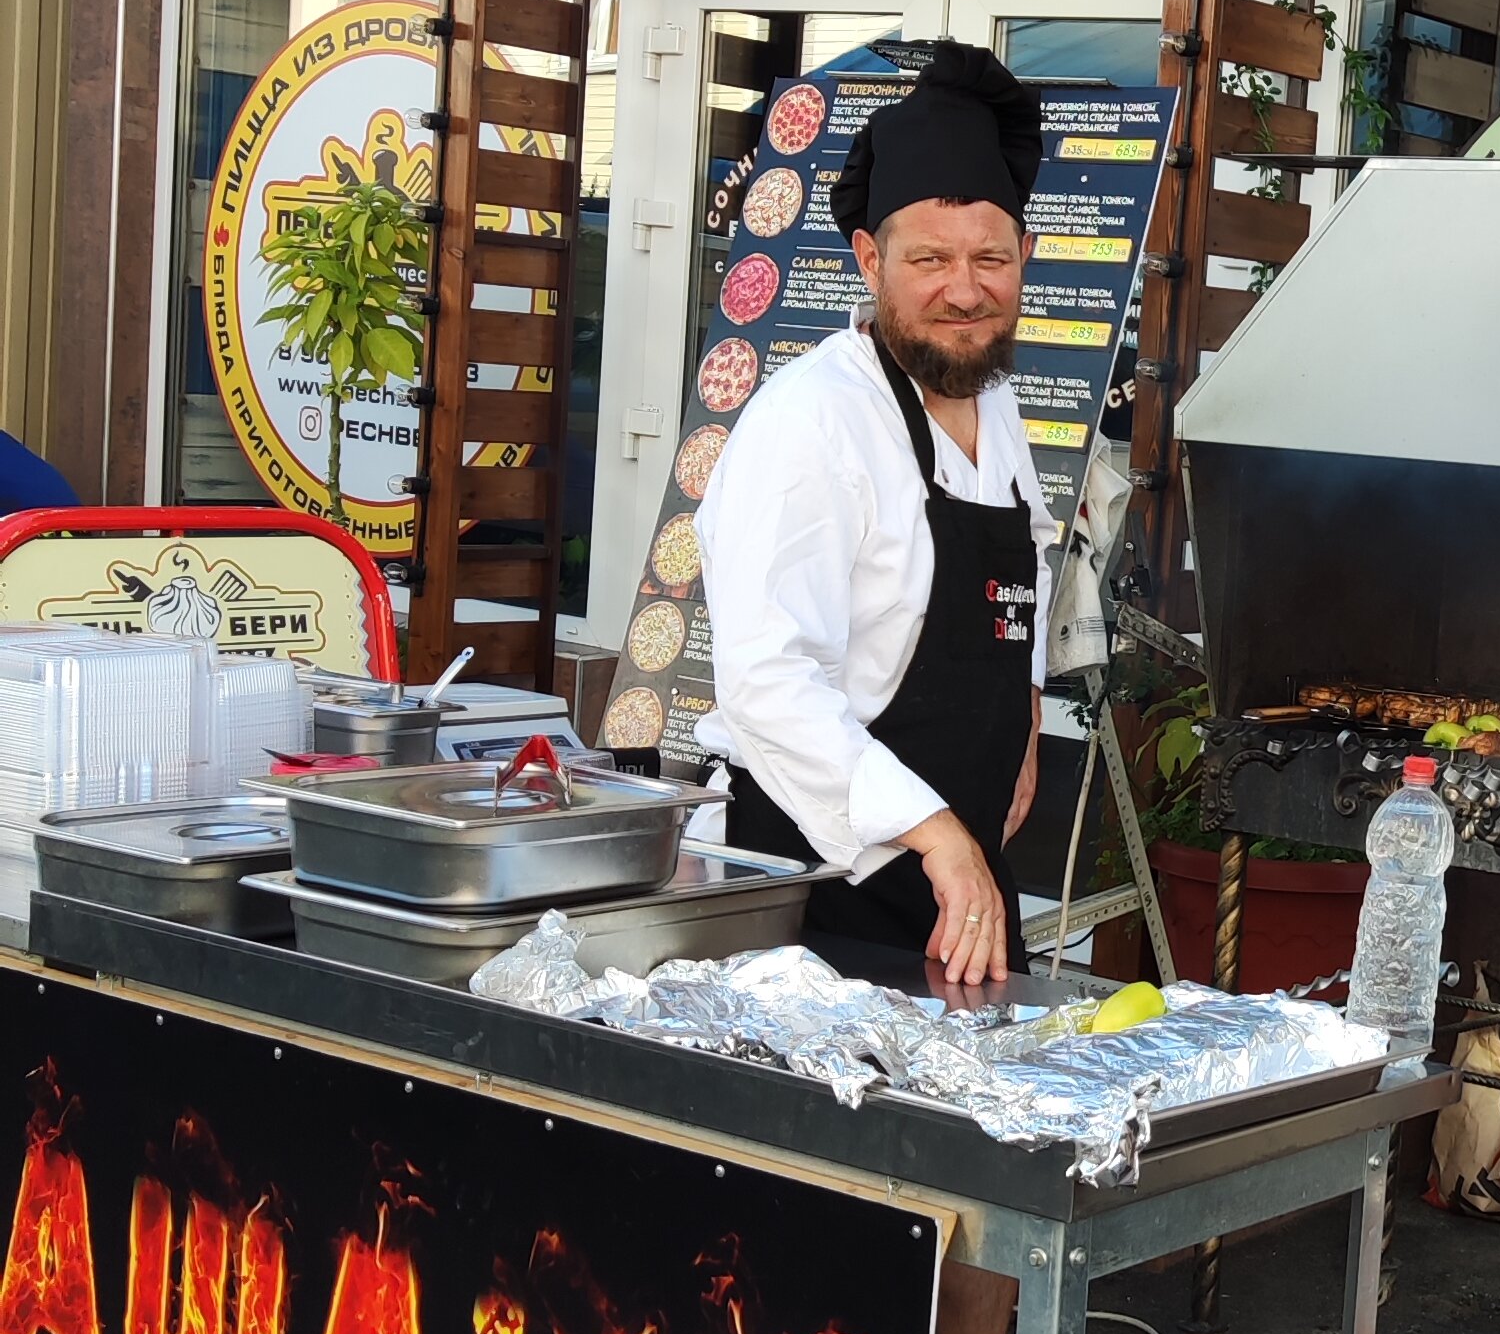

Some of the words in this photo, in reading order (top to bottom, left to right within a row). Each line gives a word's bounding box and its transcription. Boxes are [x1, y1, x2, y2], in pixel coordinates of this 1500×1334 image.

[221, 77, 290, 213] ПИЦЦА
[292, 32, 336, 77] ИЗ
[1115, 143, 1137, 157] 689
[213, 254, 235, 376] БЛЮДА
[1070, 327, 1094, 340] 689
[1046, 425, 1070, 441] 689
[229, 613, 308, 637] БЕРИ
